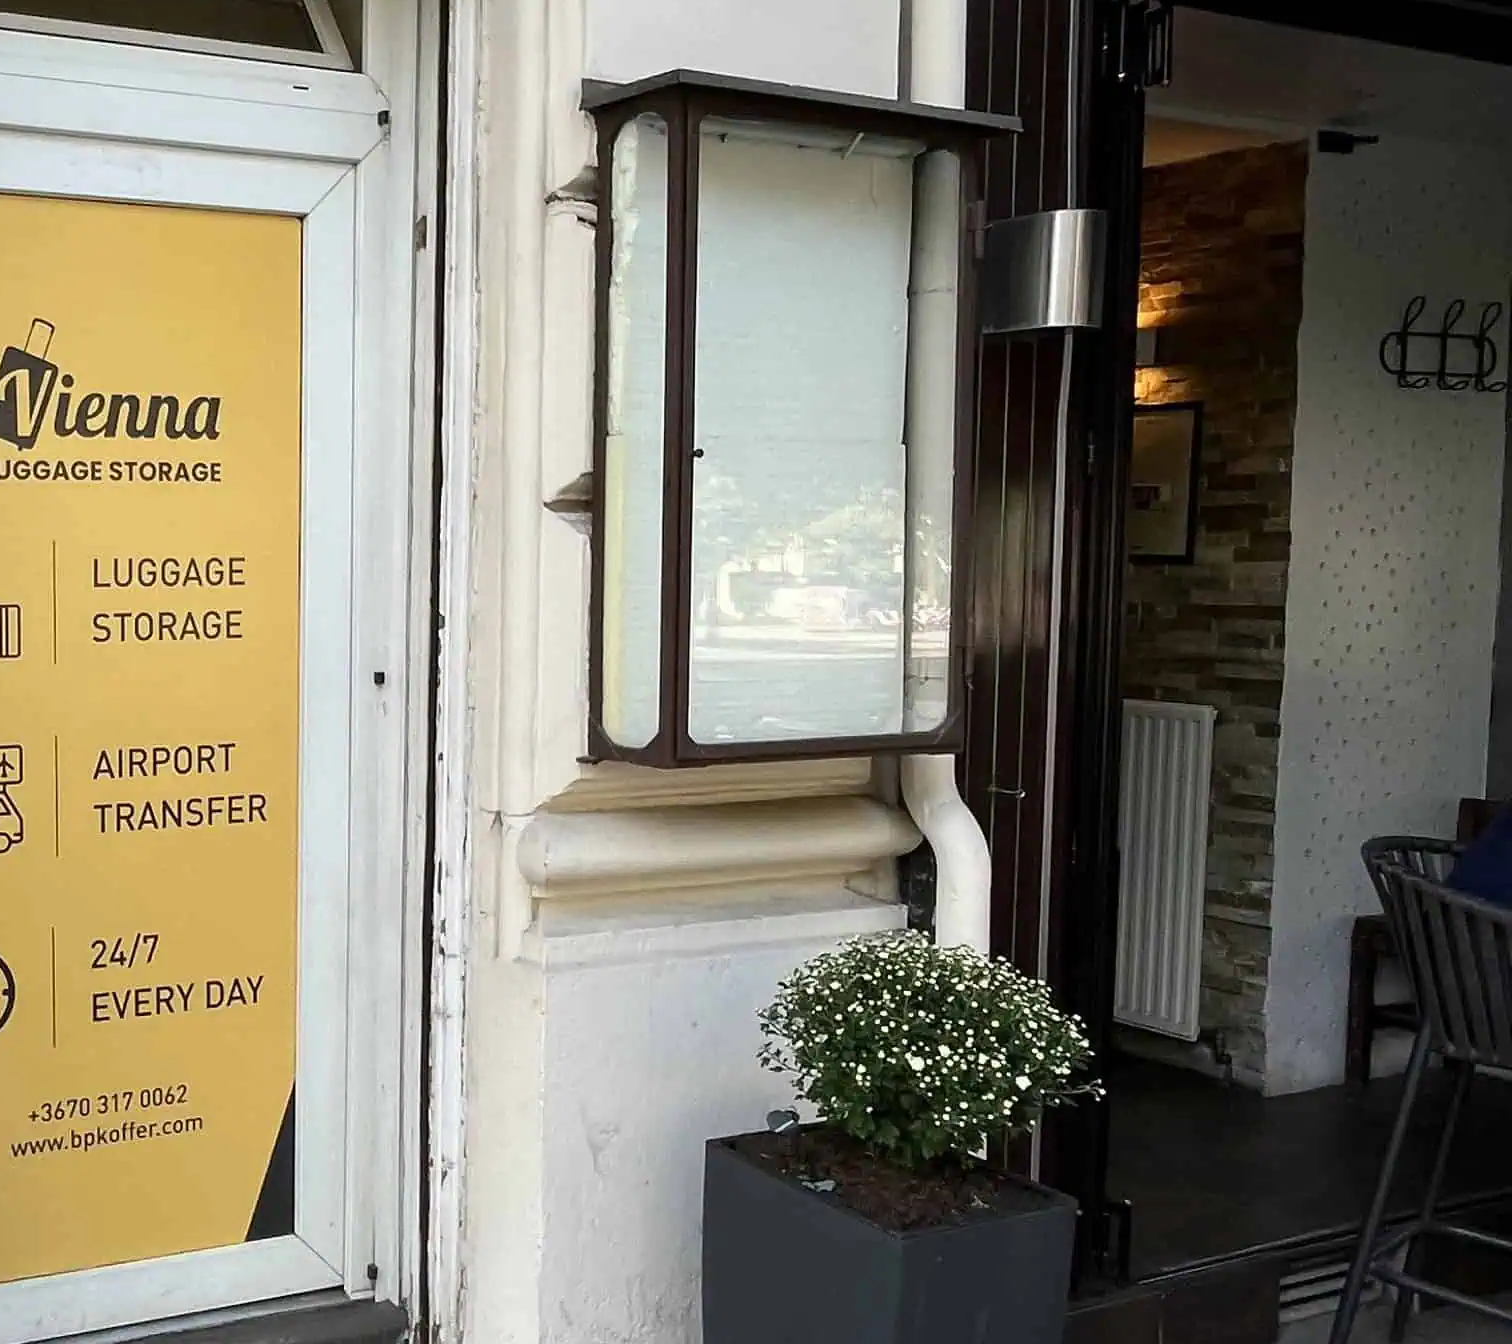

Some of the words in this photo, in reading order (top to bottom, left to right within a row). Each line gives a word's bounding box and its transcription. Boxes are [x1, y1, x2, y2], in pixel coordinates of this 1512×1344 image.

[108, 461, 222, 483] STORAGE
[92, 557, 246, 588] LUGGAGE
[92, 610, 243, 642] STORAGE
[93, 743, 236, 780] AIRPORT
[93, 794, 267, 833] TRANSFER
[90, 933, 159, 969] 24/7
[91, 983, 194, 1022] EVERY
[205, 975, 264, 1009] DAY
[28, 1097, 91, 1123] +3670
[96, 1092, 133, 1115] 317
[139, 1084, 188, 1109] 0062
[11, 1115, 203, 1158] www.bpkoffer.com
